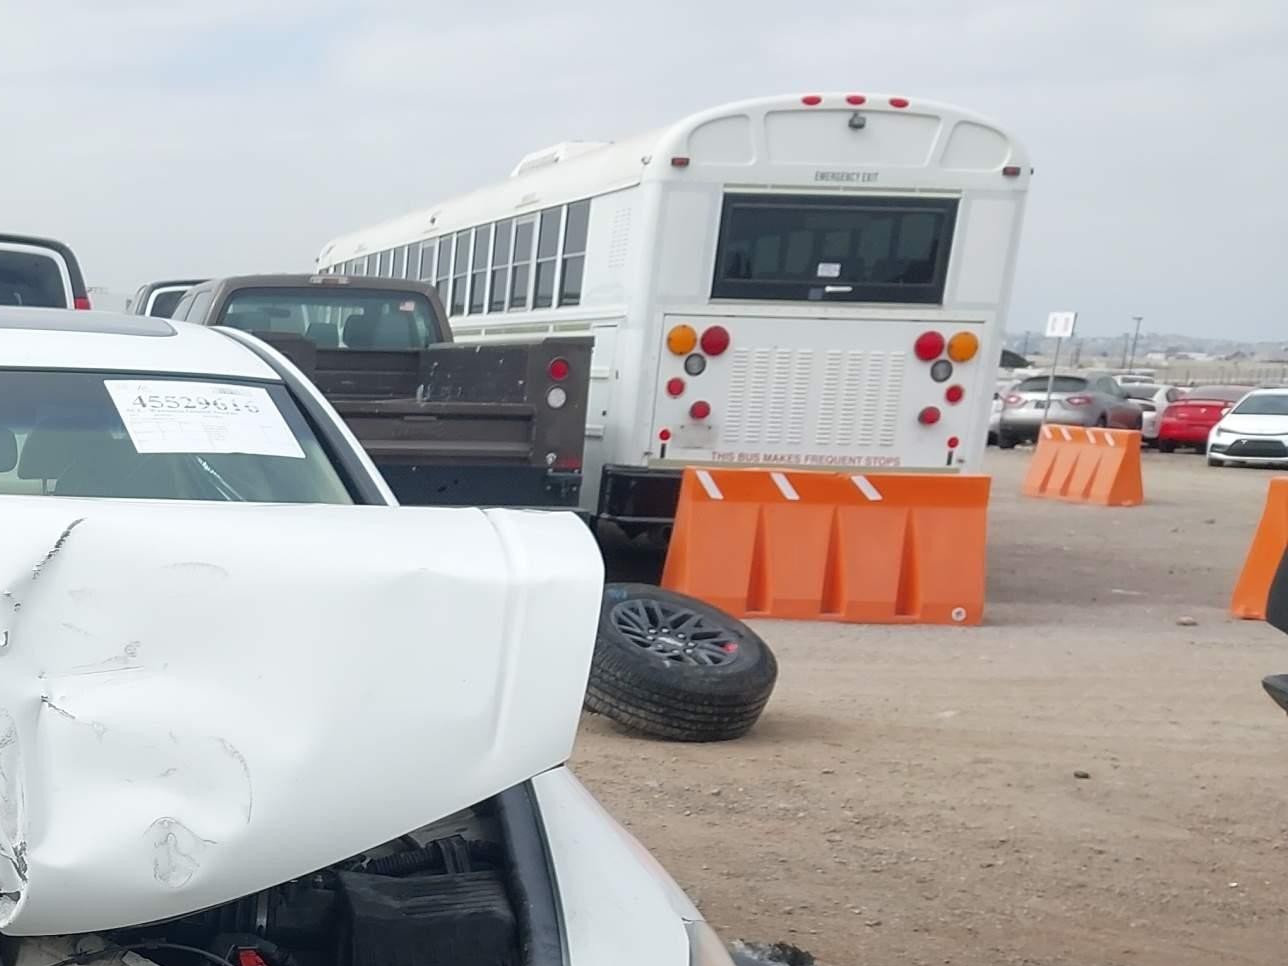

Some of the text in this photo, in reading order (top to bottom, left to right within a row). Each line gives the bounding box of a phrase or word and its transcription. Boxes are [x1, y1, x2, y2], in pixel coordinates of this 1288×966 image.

[814, 170, 879, 182] EMERGENCY EXIT
[132, 395, 260, 414] 45529616
[712, 451, 902, 467] THIS BUS MAKES FREQUENT STOPS
